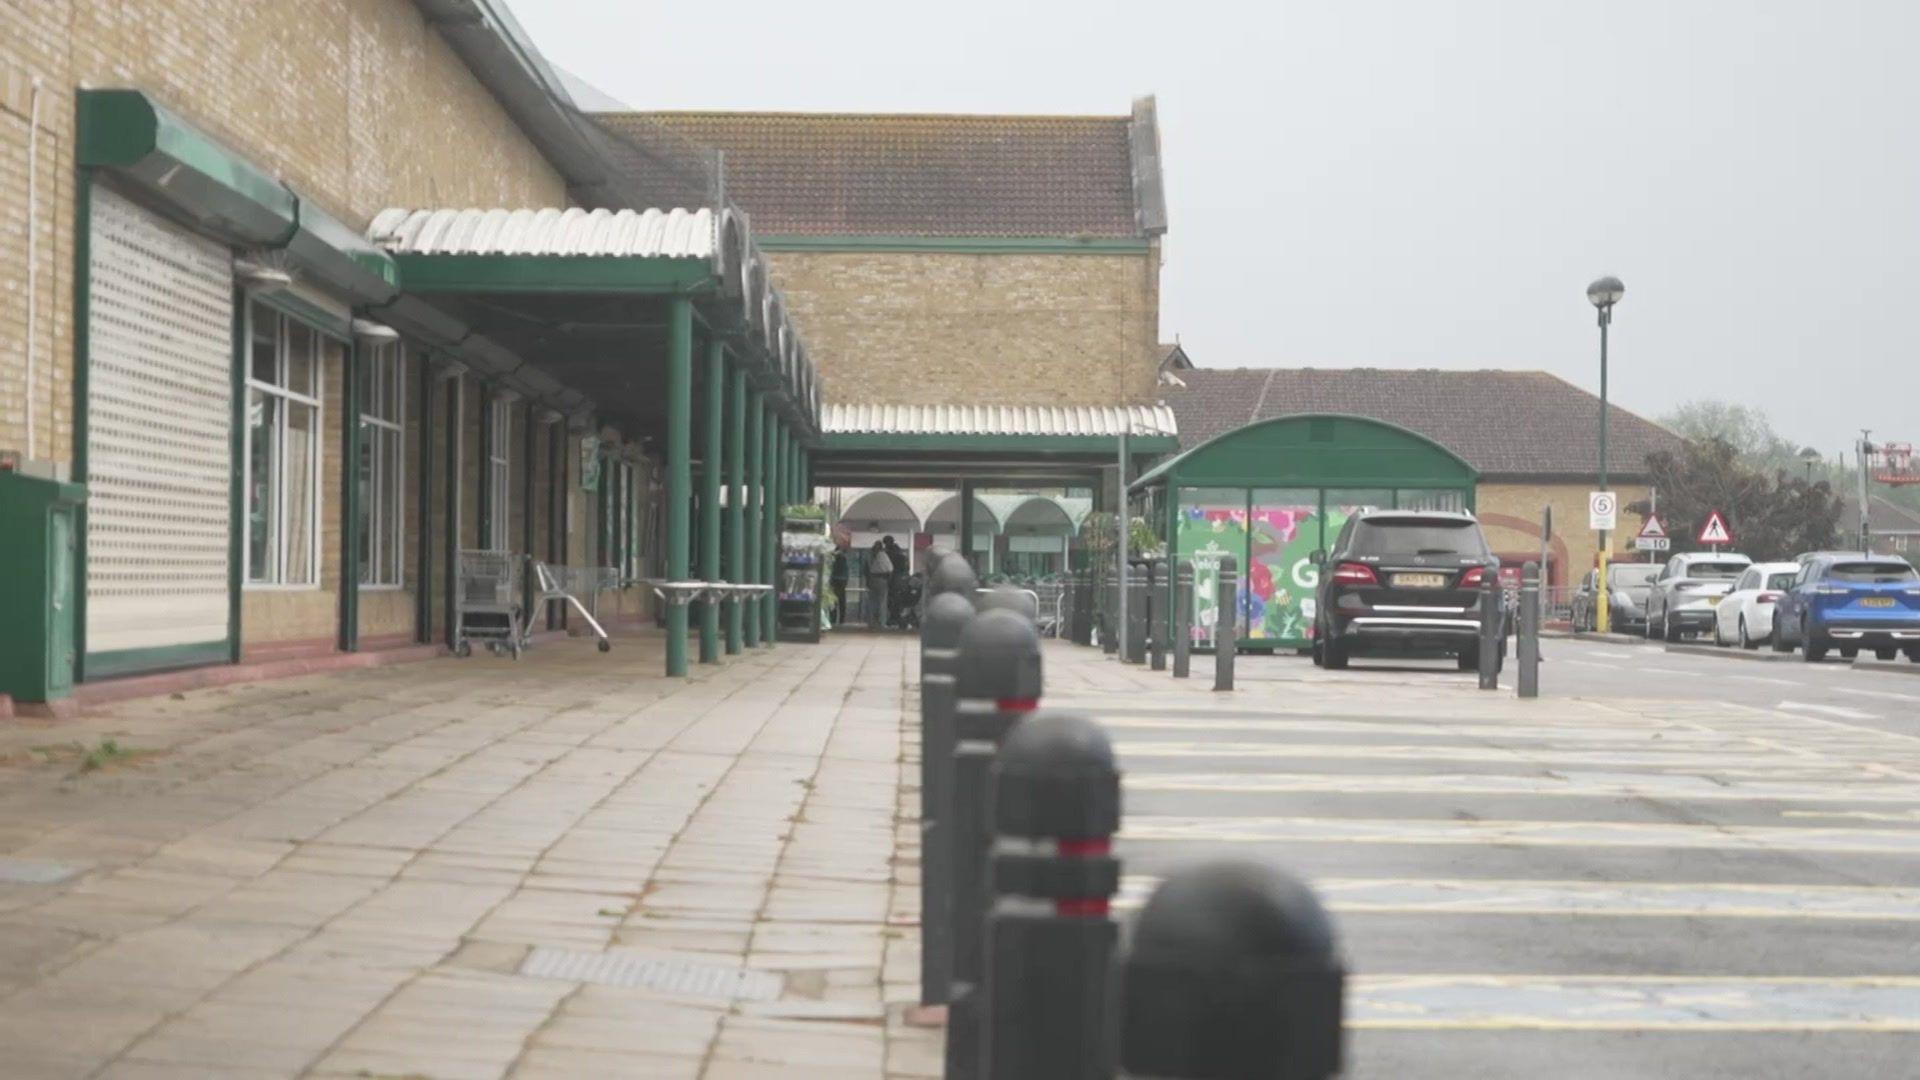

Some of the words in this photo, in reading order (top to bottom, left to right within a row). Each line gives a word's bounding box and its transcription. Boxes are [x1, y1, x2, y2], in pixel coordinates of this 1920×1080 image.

[1598, 499, 1607, 511] 5
[1654, 539, 1667, 549] 10
[1291, 557, 1320, 588] G
